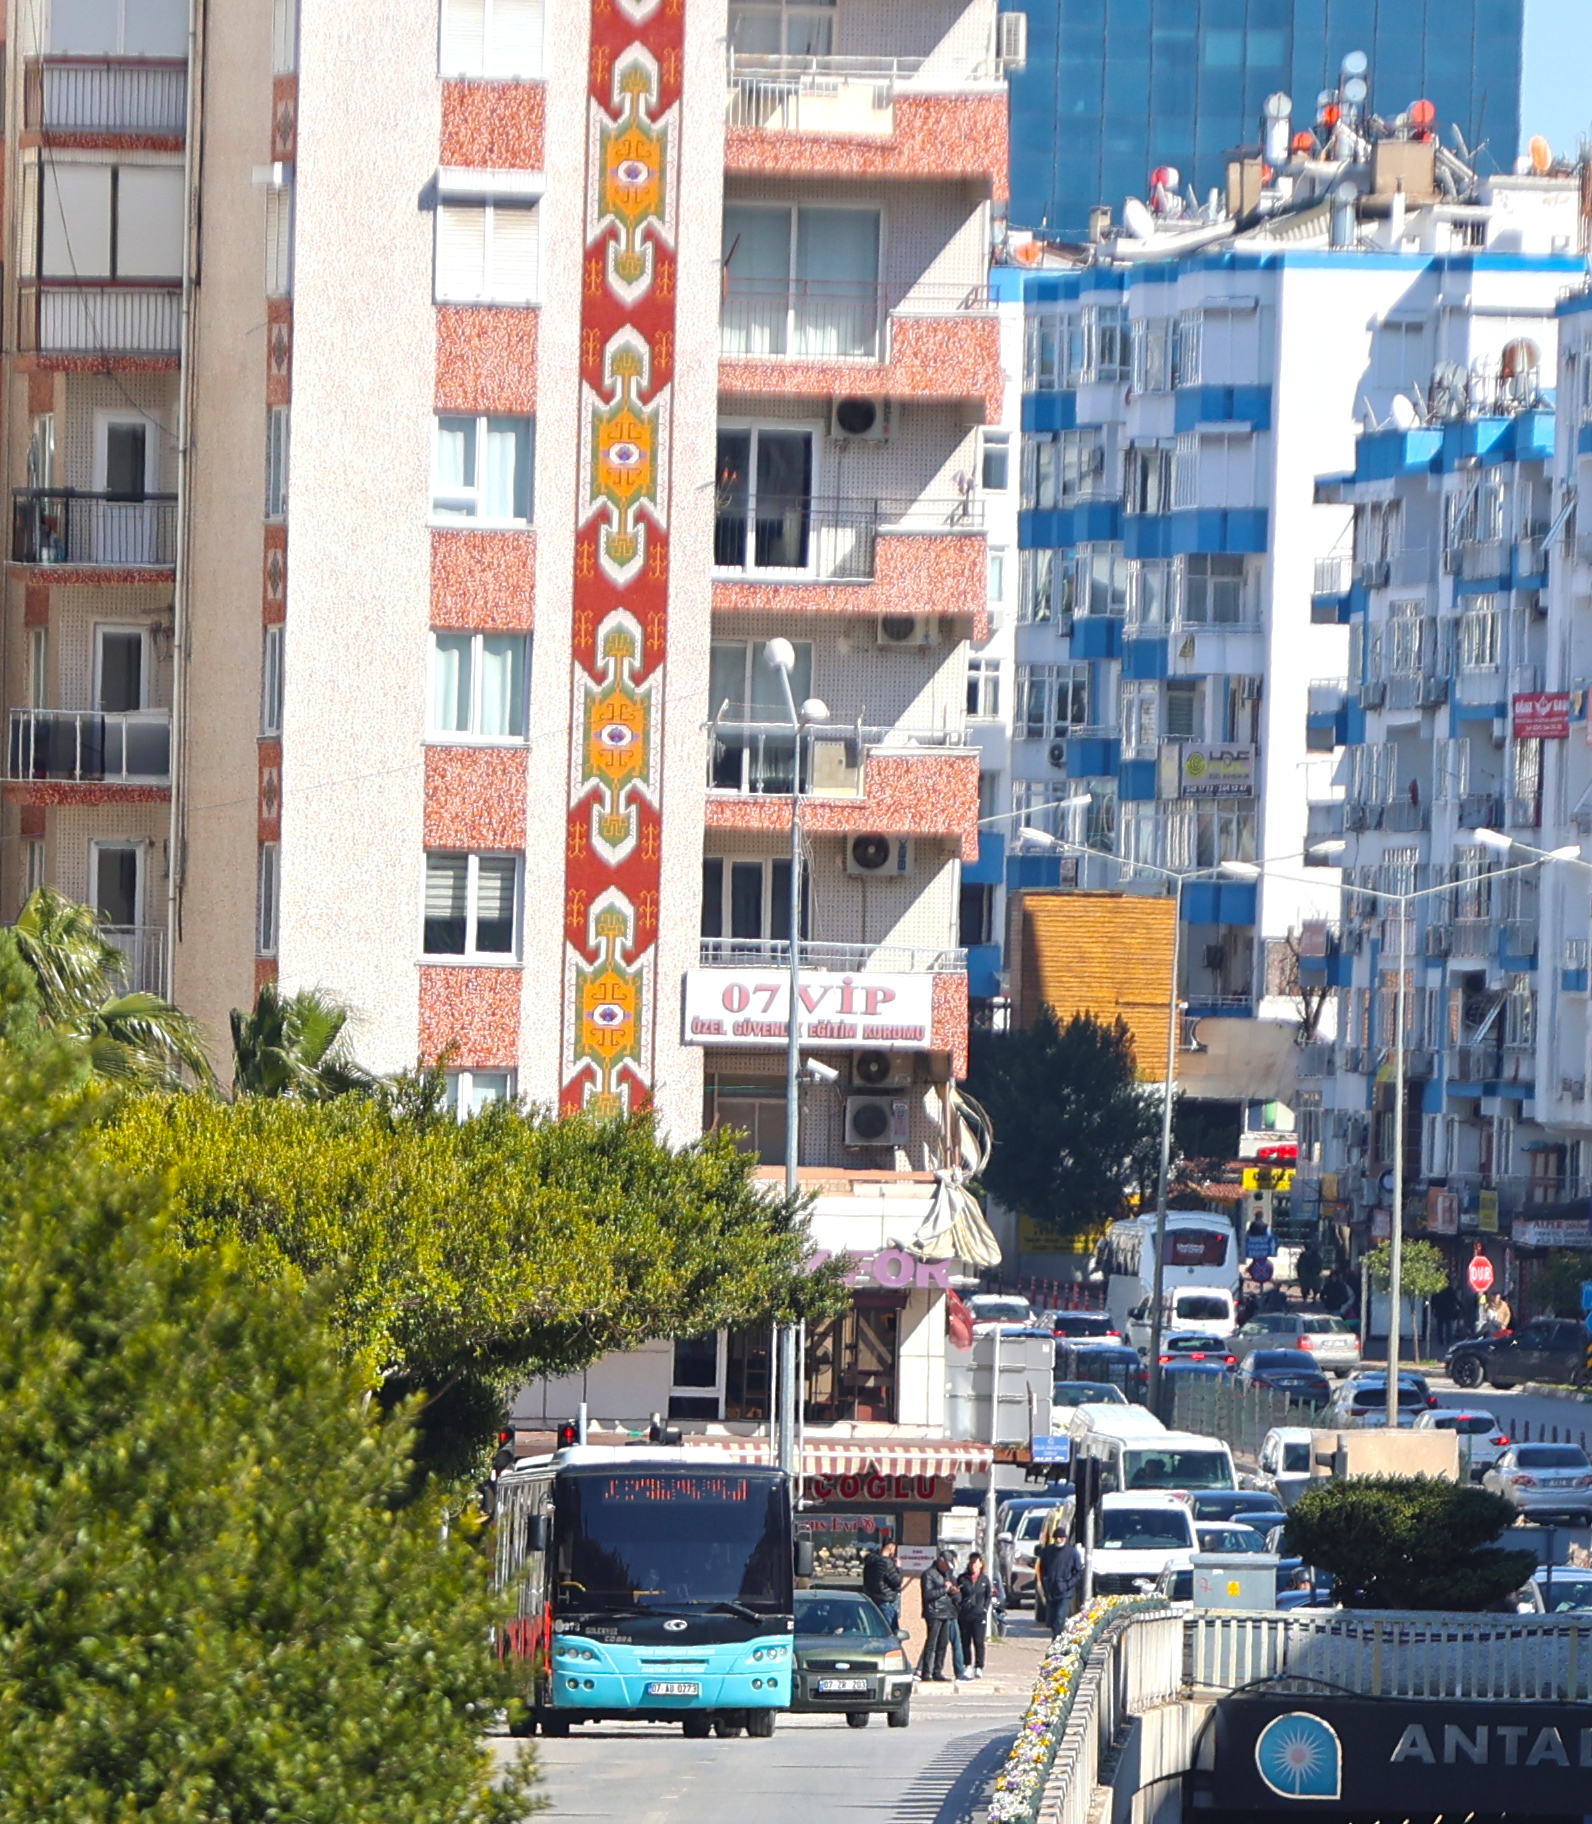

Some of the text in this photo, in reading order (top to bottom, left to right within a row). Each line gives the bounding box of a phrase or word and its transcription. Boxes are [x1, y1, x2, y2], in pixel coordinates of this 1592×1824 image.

[722, 976, 896, 1015] 07 VİP
[691, 1016, 926, 1041] ÖZEL GÜVENL EĞİTİM KURUMU
[1471, 1266, 1491, 1281] DUR
